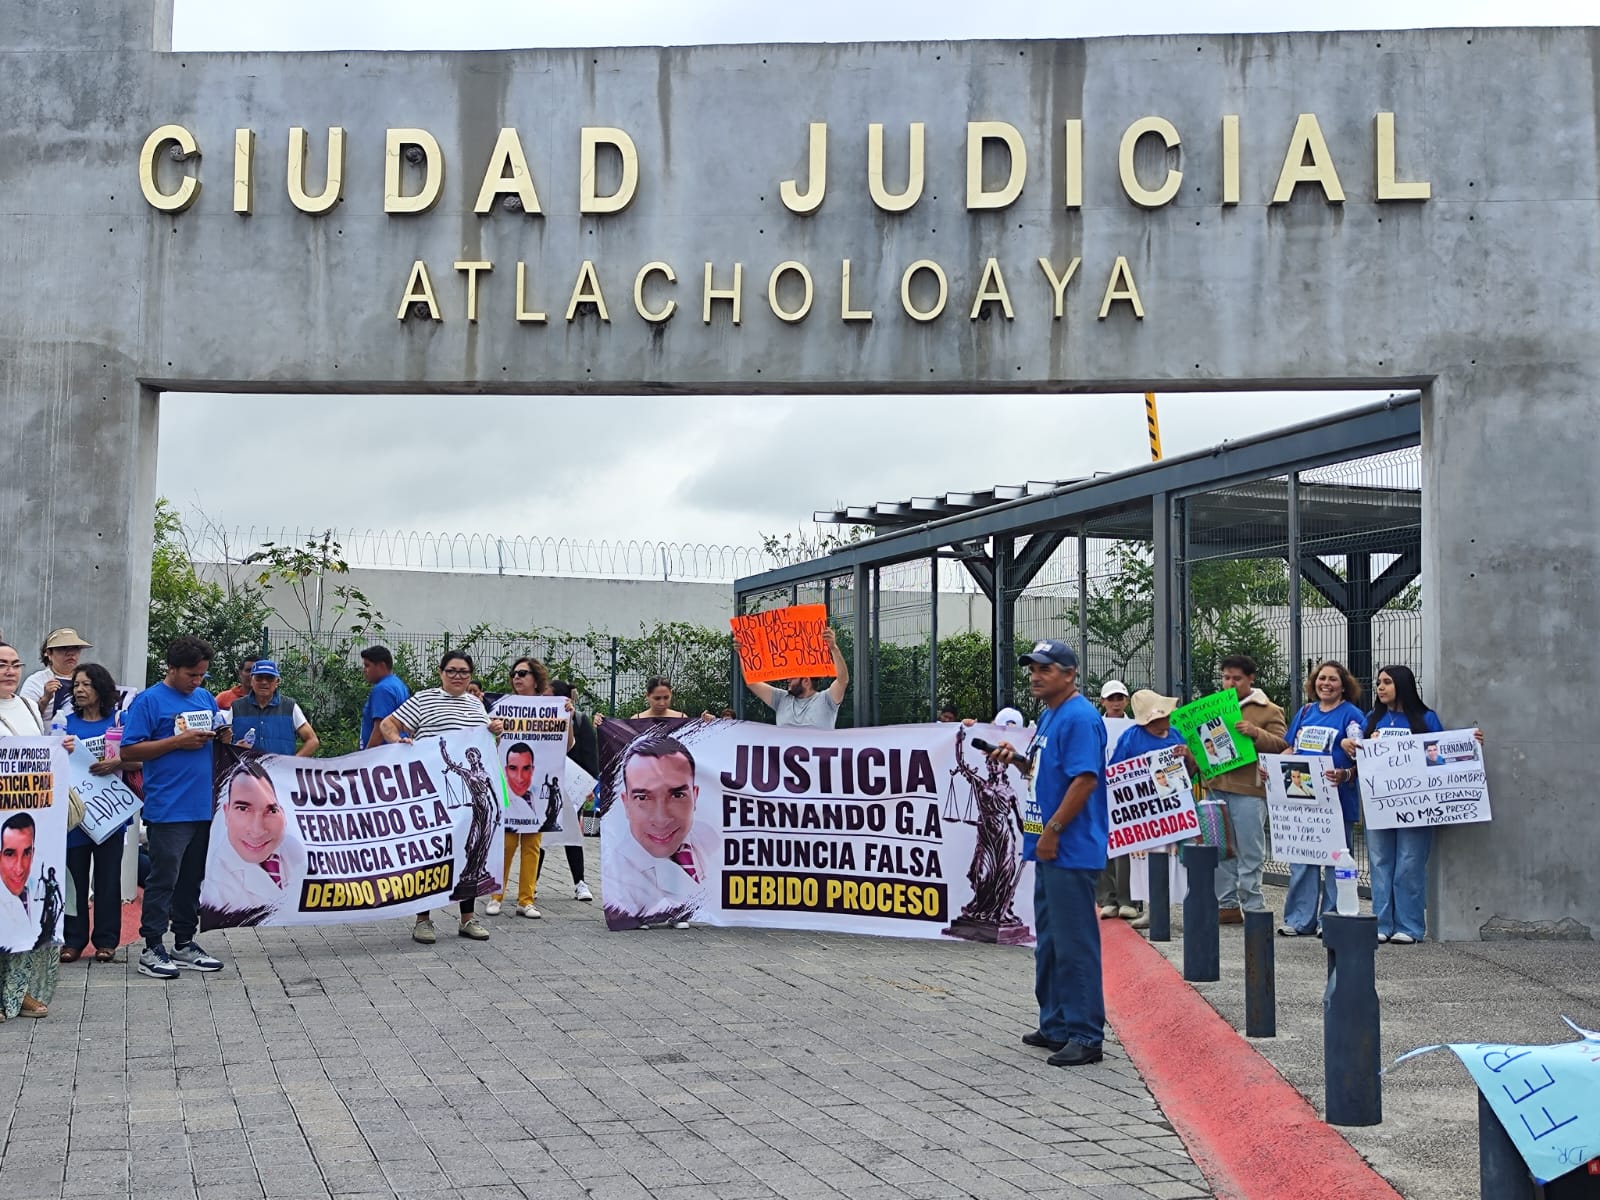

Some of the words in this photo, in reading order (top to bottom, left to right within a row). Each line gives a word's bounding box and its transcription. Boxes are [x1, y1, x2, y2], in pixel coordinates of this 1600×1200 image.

[139, 125, 640, 216] CIUDAD
[780, 112, 1431, 214] JUDICIAL
[397, 257, 1144, 323] ATLACHOLOAYA
[735, 626, 756, 643] SIN
[743, 653, 762, 672] NO
[771, 652, 788, 668] ES
[496, 705, 537, 718] JUSTICIA
[539, 707, 558, 718] CON
[517, 719, 524, 731] A
[526, 720, 566, 732] DERECHO
[8, 748, 20, 760] UN
[21, 748, 50, 760] PROCESO
[1397, 740, 1419, 752] POR
[1440, 741, 1473, 754] FERNANDO
[11, 762, 17, 773] E
[720, 744, 938, 795] JUSTICIA
[290, 760, 437, 807] JUSTICIA
[1365, 776, 1375, 796] Y
[1386, 776, 1421, 792] TODOS
[1428, 776, 1443, 787] LOS
[1113, 785, 1134, 805] NO
[1371, 794, 1430, 811] JUSTICIA
[1435, 790, 1483, 801] FERNANDO
[722, 794, 886, 832] FERNANDO
[895, 801, 943, 839] G.A
[1111, 794, 1181, 825] CARPETAS
[1396, 812, 1415, 823] NO
[1418, 807, 1444, 819] MAS
[1446, 803, 1478, 814] PRESOS
[1426, 812, 1478, 824] INOCENTES
[296, 807, 406, 843] FERNANDO
[409, 800, 452, 831] G.A
[1108, 809, 1197, 850] FABRICADAS
[1293, 816, 1302, 824] EL
[1321, 826, 1331, 834] LO
[1300, 835, 1322, 843] ERES
[307, 846, 395, 876] DENUNCIA
[395, 833, 453, 866] FALSA
[724, 838, 856, 871] DENUNCIA
[864, 843, 943, 879] FALSA
[1286, 846, 1328, 859] FERNANDO
[306, 880, 375, 908] DEBIDO
[376, 864, 450, 903] PROCESO
[729, 875, 819, 907] DEBIDO
[826, 879, 940, 917] PROCESO
[1552, 1145, 1590, 1166] DR.
